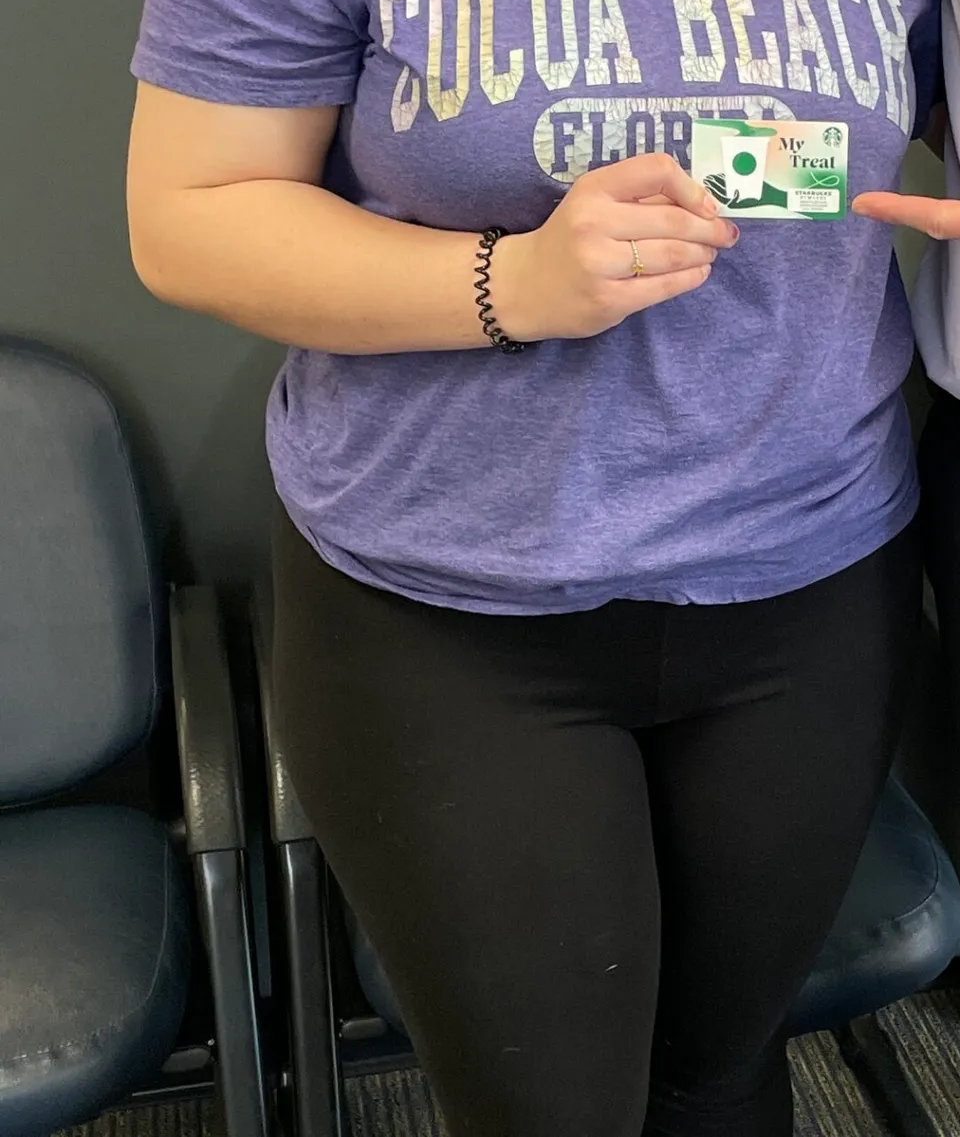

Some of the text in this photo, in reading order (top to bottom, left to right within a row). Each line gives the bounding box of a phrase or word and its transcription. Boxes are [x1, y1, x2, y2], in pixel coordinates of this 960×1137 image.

[550, 107, 778, 176] FLOR
[779, 137, 805, 154] My
[789, 155, 836, 170] Treat
